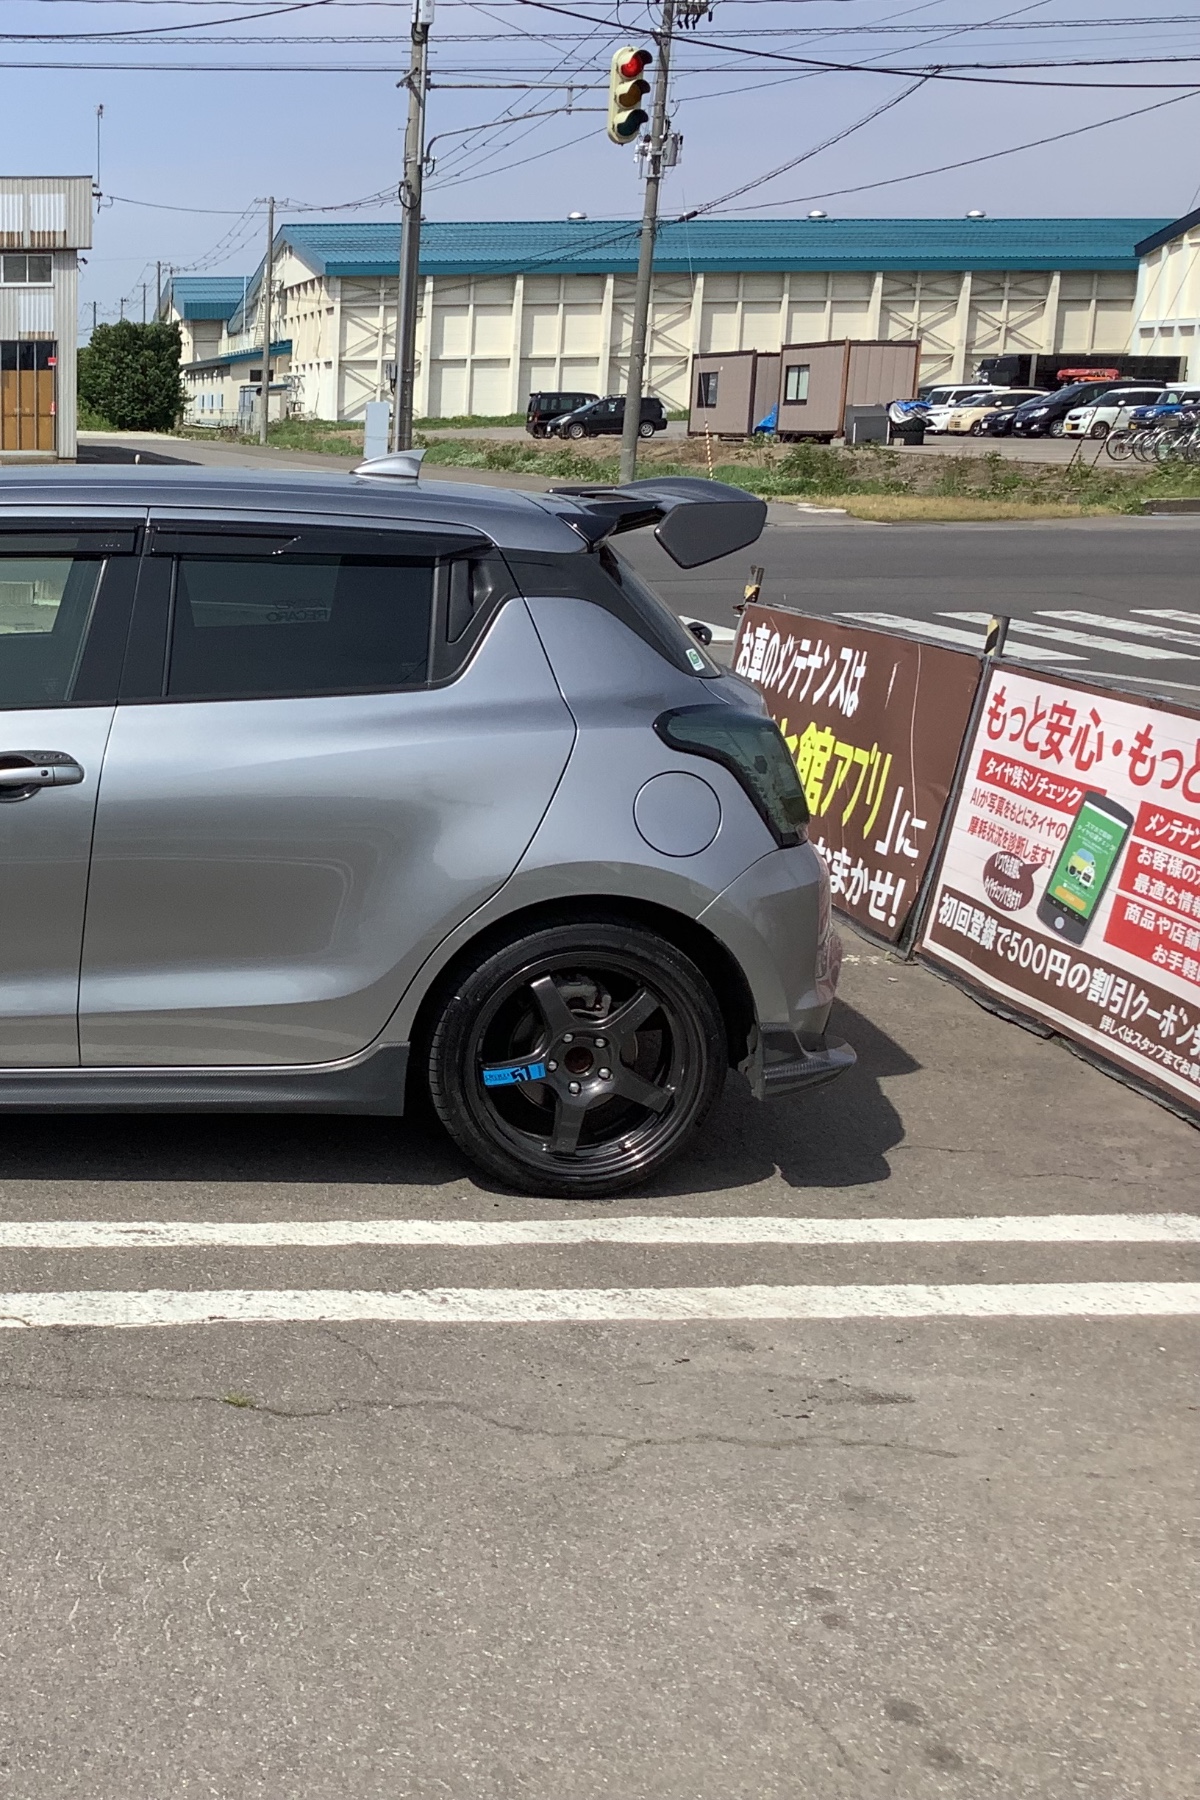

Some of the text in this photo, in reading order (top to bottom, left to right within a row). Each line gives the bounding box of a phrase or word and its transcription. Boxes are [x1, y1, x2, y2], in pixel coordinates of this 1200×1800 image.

[736, 621, 868, 717] お車のメンテナンスは
[985, 757, 1083, 807] タイヤ残ミゾチェック
[970, 787, 1068, 841] AIが写真をもとにタイヤの
[1152, 944, 1200, 982] お手軽
